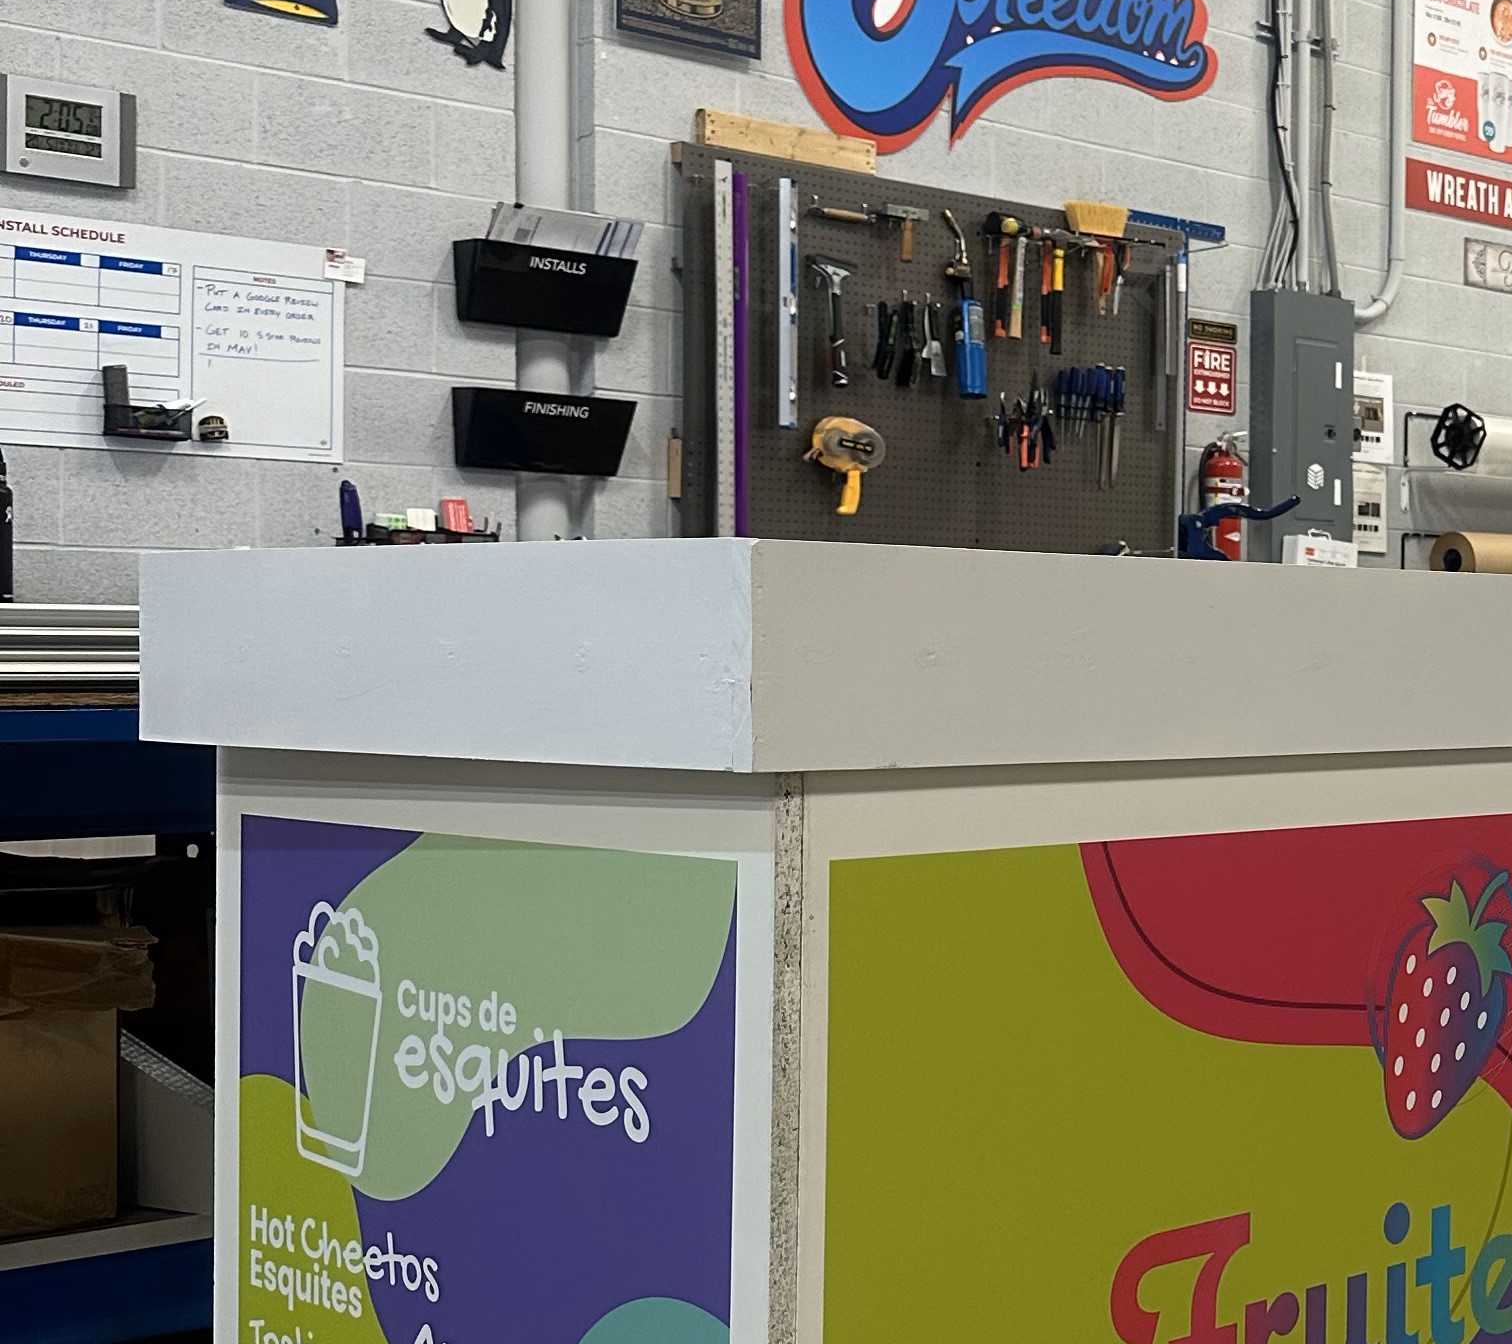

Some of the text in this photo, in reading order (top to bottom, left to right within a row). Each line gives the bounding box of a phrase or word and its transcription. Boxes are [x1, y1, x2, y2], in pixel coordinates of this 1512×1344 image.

[1426, 169, 1500, 216] WREATH
[51, 225, 126, 244] SCHEDULE
[28, 250, 67, 261] THURSDAY
[118, 260, 145, 270] FRIDAY
[529, 256, 588, 275] INSTALLS
[27, 316, 66, 326] THURSDAY
[117, 324, 143, 334] FRIDAY
[1193, 349, 1231, 372] FIRE
[522, 401, 590, 419] FINISHING
[396, 979, 517, 1036] Cups de
[394, 1028, 651, 1143] esquites
[250, 1204, 440, 1303] Hot Cheetos
[250, 1249, 364, 1320] Esquites
